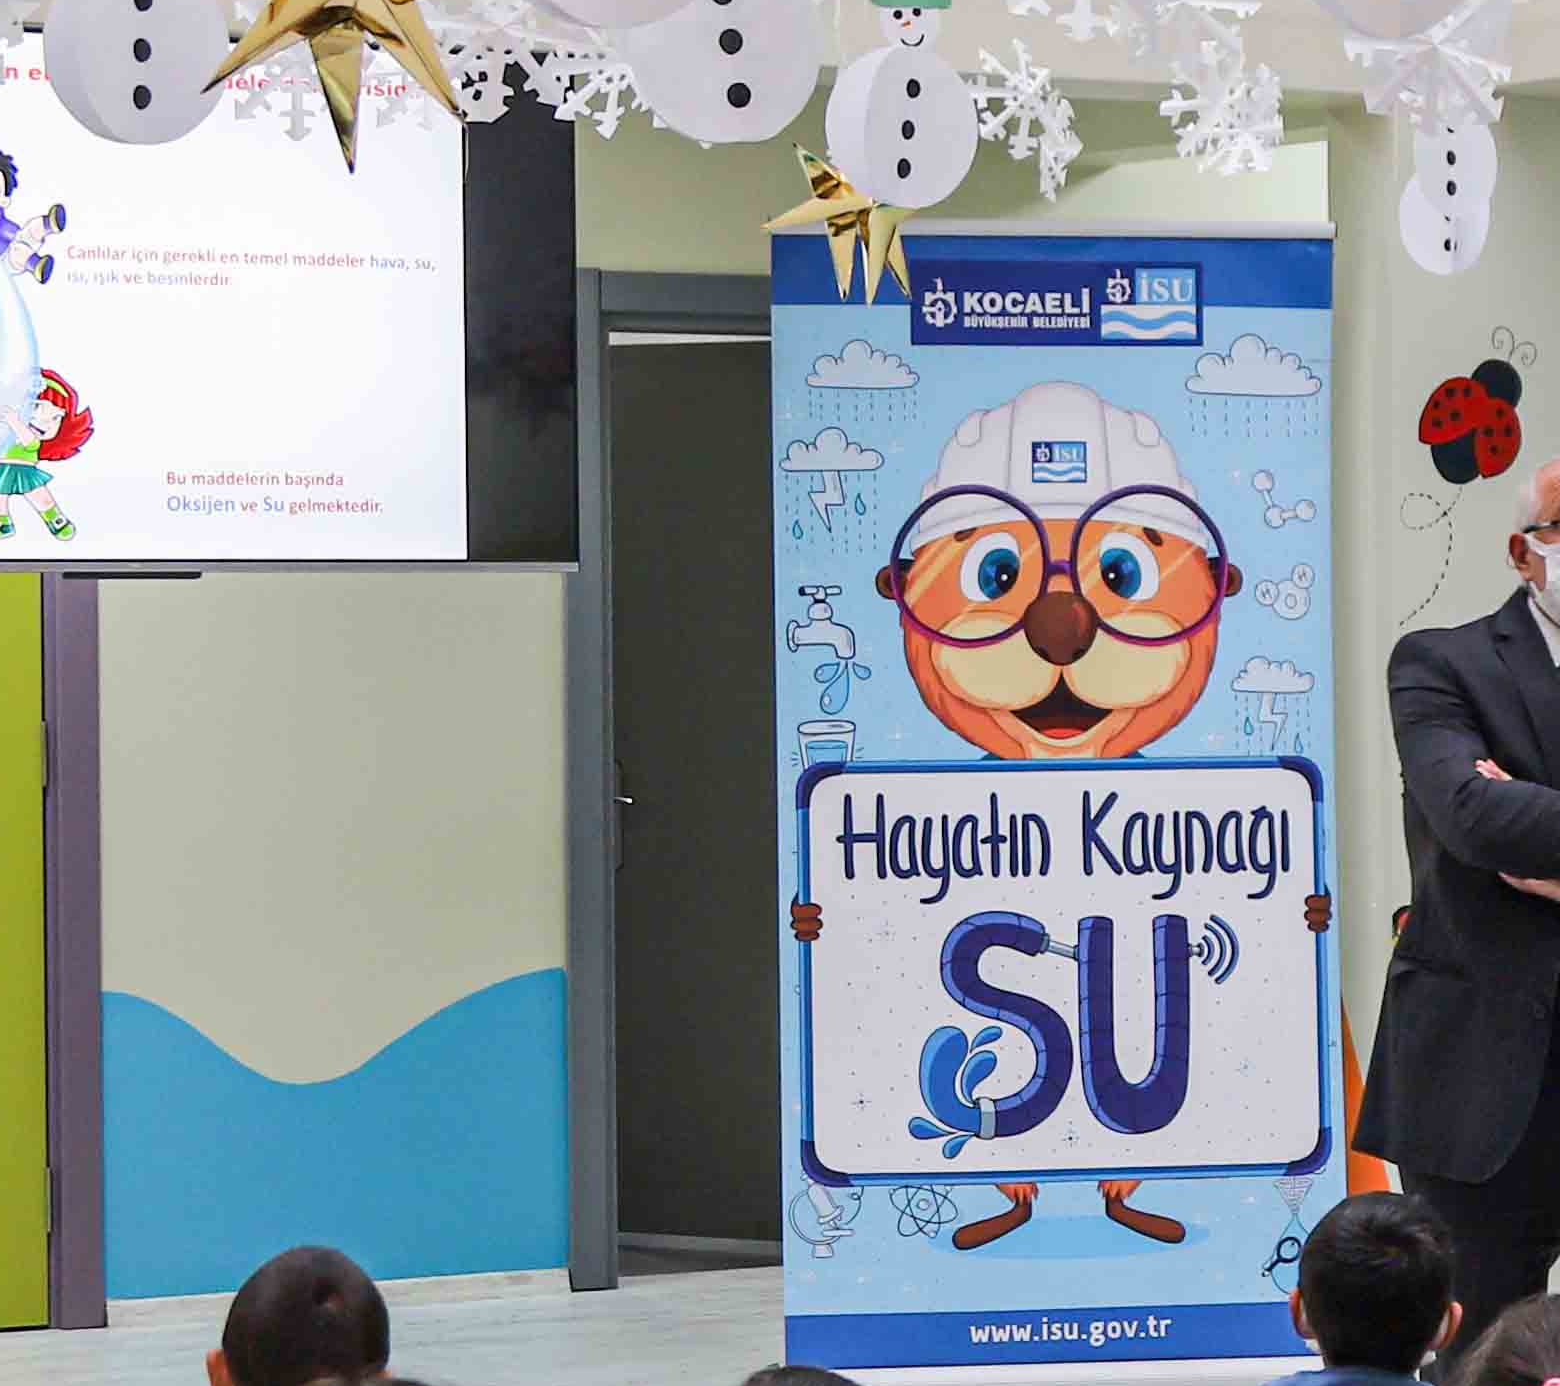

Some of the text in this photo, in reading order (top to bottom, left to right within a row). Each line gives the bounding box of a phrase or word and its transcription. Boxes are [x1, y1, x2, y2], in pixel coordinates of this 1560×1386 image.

[220, 253, 239, 264] en
[293, 253, 365, 268] maddeler
[124, 273, 143, 284] ve
[1139, 272, 1193, 303] İSU
[963, 287, 1091, 314] KOCAELİ
[166, 471, 344, 489] Bu maddelerin başında
[167, 495, 384, 515] Oksijen ve Su gelmektedir.
[836, 790, 1290, 904] Hayatın Kaynağı
[919, 911, 1191, 1139] SU
[970, 1315, 1173, 1347] www.isu.gov.tr
